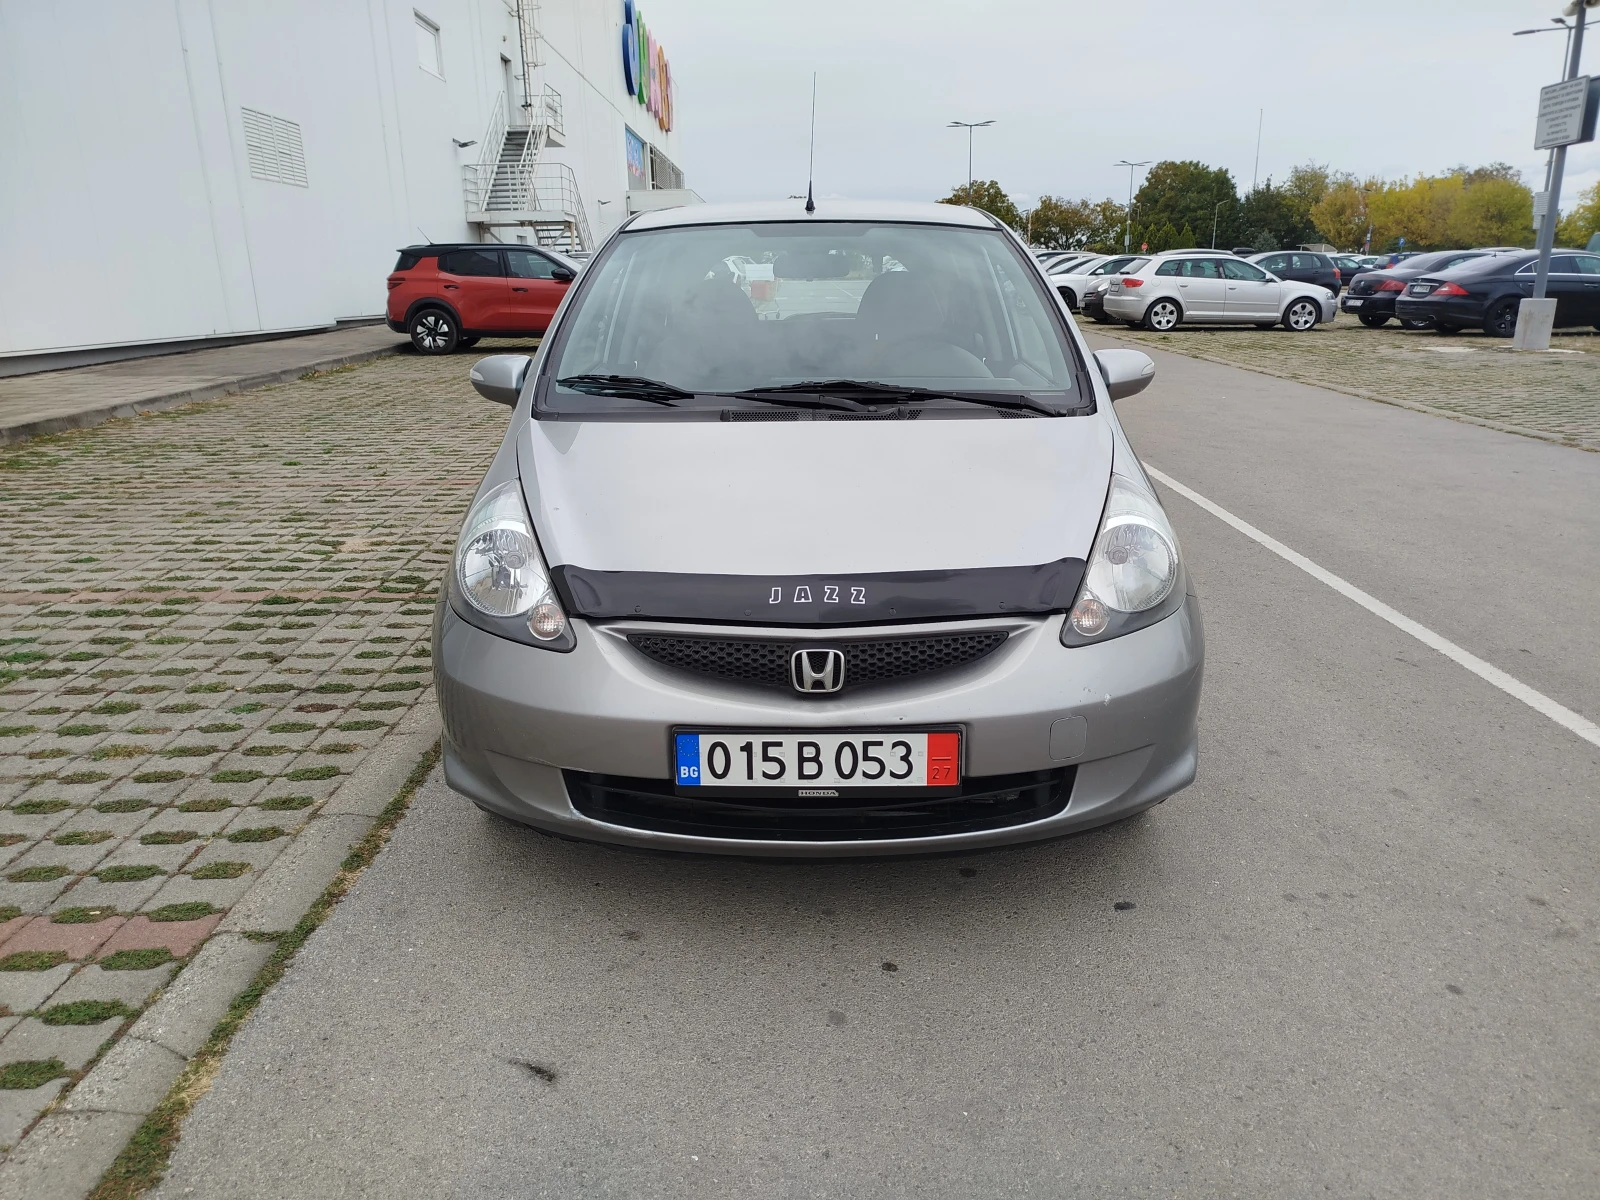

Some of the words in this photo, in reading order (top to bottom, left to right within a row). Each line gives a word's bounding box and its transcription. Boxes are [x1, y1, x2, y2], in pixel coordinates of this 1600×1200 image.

[769, 585, 866, 604] JAZZ
[680, 766, 698, 778] BG
[932, 766, 951, 780] 27
